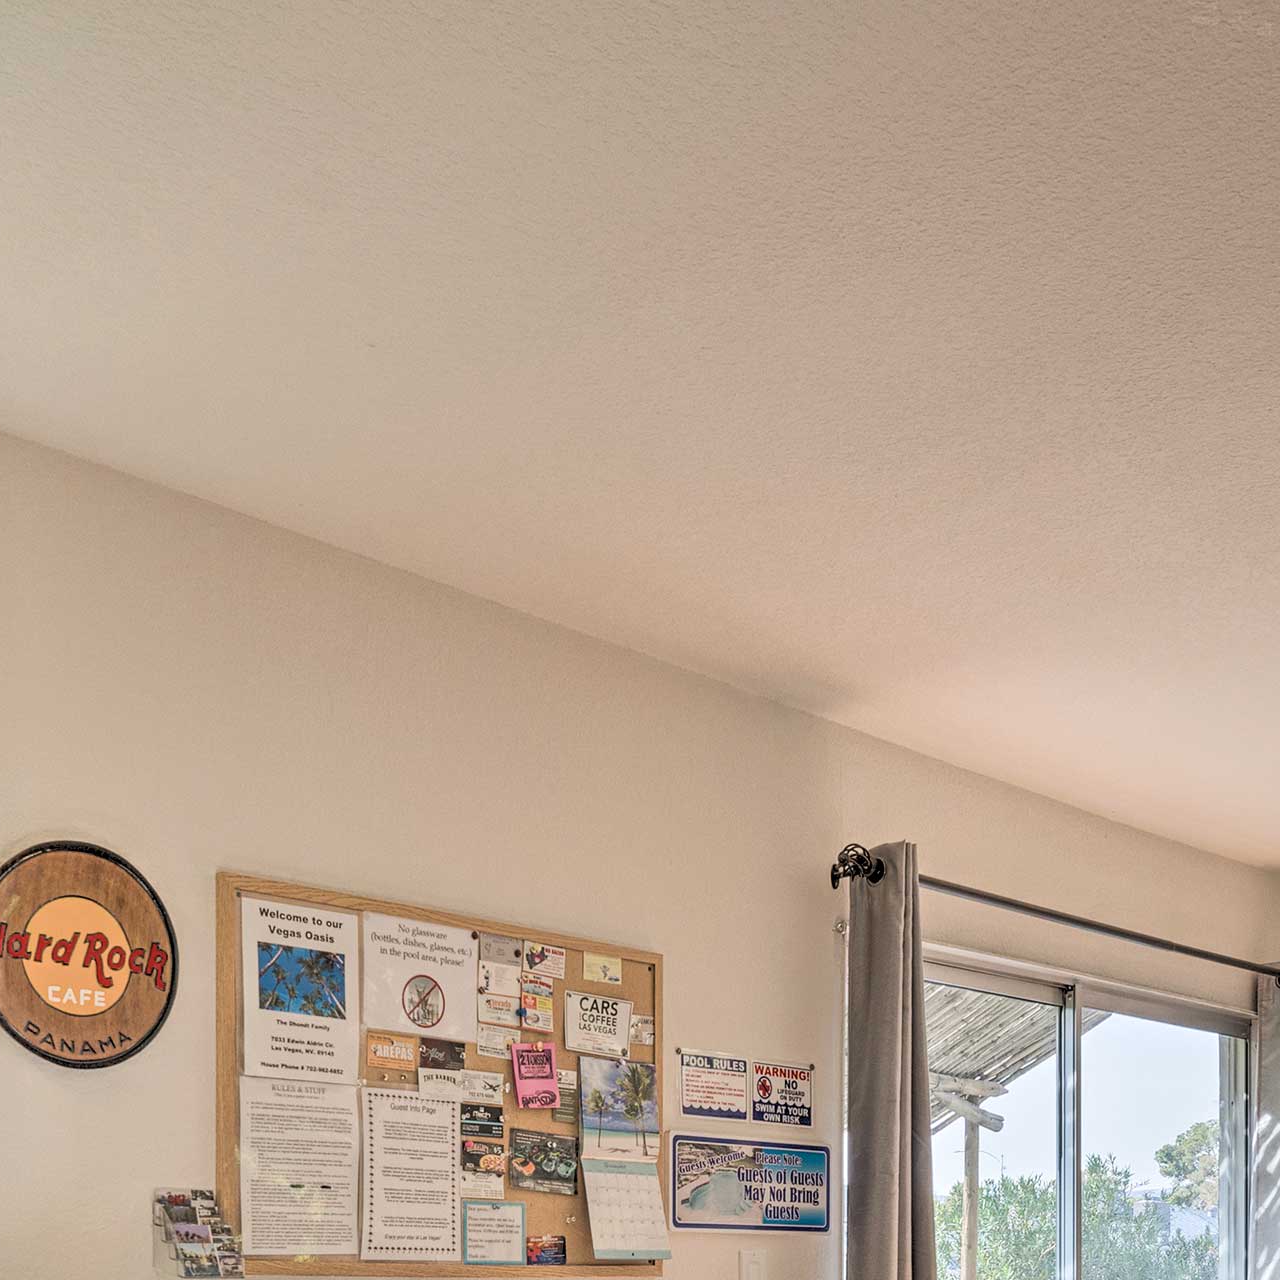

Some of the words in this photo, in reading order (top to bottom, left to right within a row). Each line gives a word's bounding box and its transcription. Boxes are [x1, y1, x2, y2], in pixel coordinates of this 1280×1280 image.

[259, 907, 309, 924] Welcome
[312, 917, 323, 926] to
[326, 920, 343, 929] our
[268, 924, 302, 938] Vegas
[305, 931, 335, 944] Oasis
[398, 924, 409, 933] No
[411, 926, 447, 940] glassware
[380, 946, 388, 954] in
[389, 947, 401, 956] the
[403, 951, 420, 960] pool
[82, 931, 169, 992] Rock
[47, 985, 107, 1007] CAFE
[580, 997, 619, 1016] CARS
[582, 1013, 617, 1027] COFFEE
[579, 1023, 591, 1032] LAS
[593, 1025, 617, 1036] VEGAS
[23, 1020, 132, 1056] PANAMA
[683, 1055, 711, 1068] POOL
[713, 1059, 745, 1071] RULES
[754, 1064, 810, 1081] WARNING!
[777, 1088, 805, 1097] LIFEGUARD
[784, 1080, 798, 1090] NO
[390, 1103, 408, 1112] Guest
[422, 1106, 437, 1115] Page
[755, 1104, 775, 1113] SWIM
[777, 1105, 786, 1114] AT
[788, 1107, 809, 1117] YOUR
[763, 1112, 780, 1122] OWN
[782, 1115, 800, 1124] RISK
[679, 1161, 706, 1174] Guests
[708, 1150, 745, 1166] Welcome
[755, 1152, 781, 1164] Please
[783, 1155, 801, 1166] Note:
[737, 1167, 773, 1183] Guests
[776, 1169, 787, 1184] of
[791, 1170, 824, 1187] Guests
[744, 1185, 766, 1203] May
[770, 1186, 787, 1203] Not
[790, 1187, 819, 1206] Bring
[765, 1204, 800, 1220] Guests
